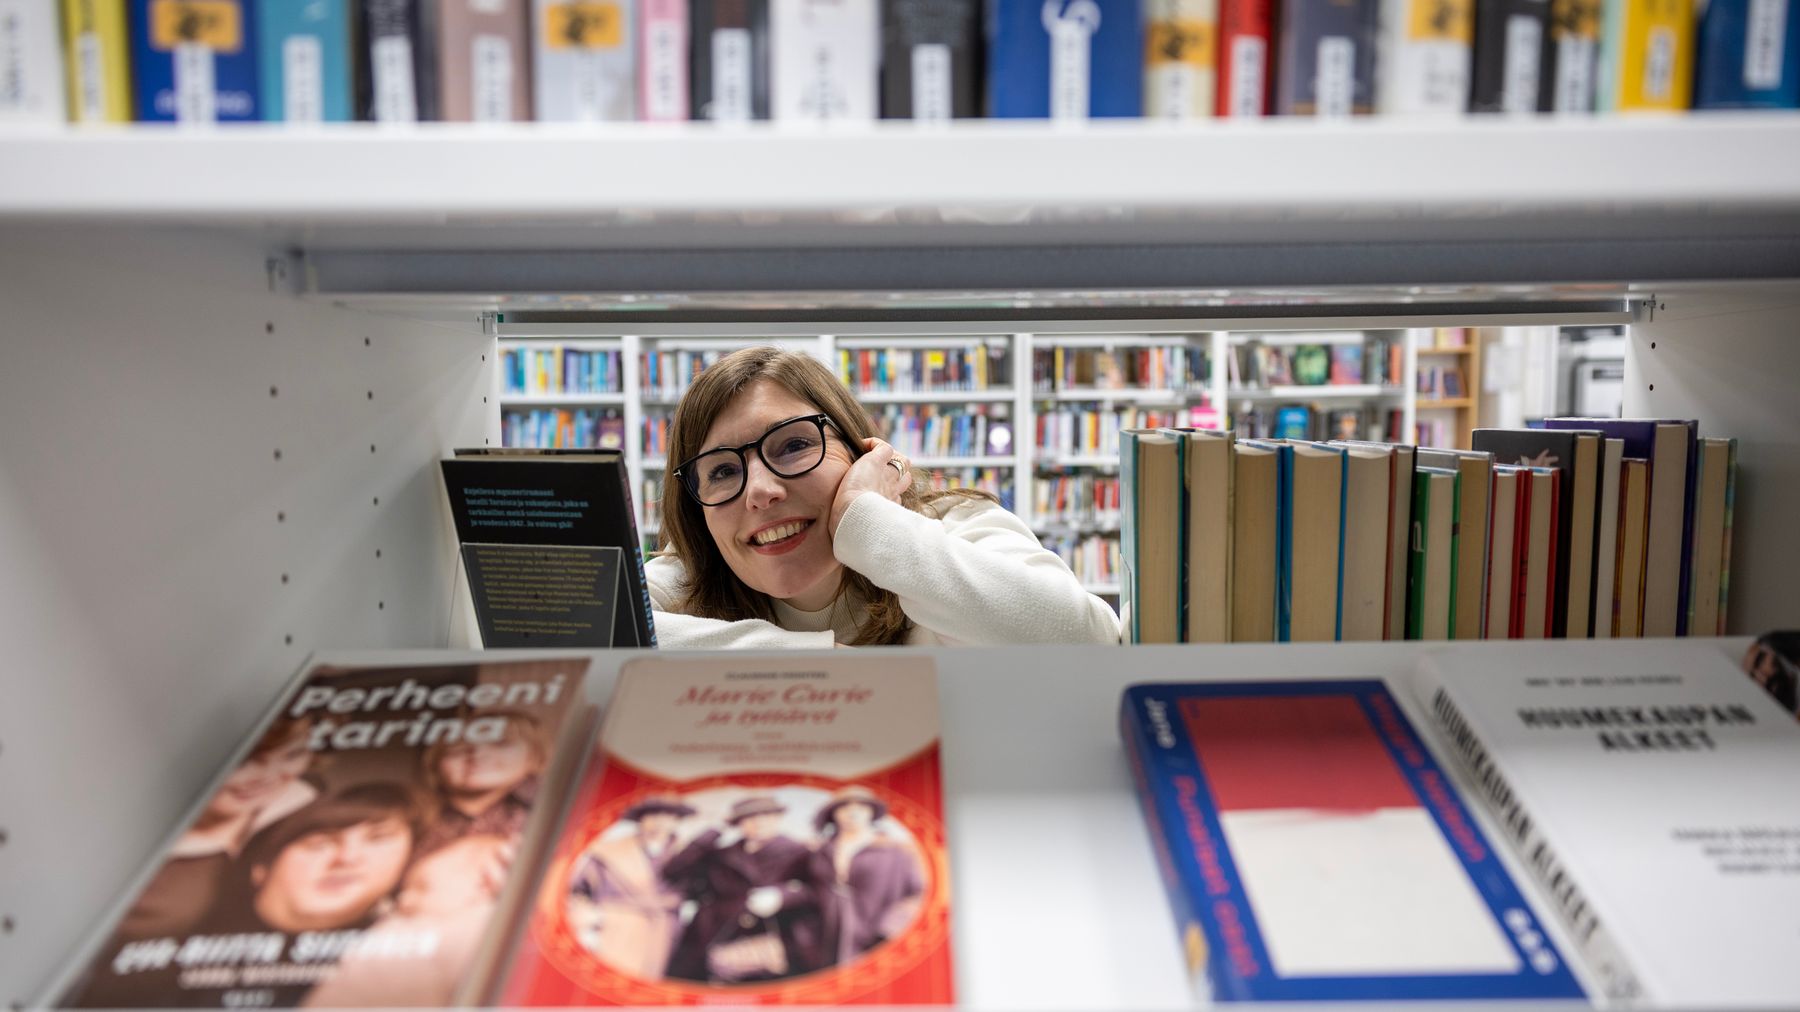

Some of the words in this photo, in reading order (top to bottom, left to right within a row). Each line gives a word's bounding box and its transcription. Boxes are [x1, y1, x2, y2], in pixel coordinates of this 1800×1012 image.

[674, 684, 776, 707] Marie
[781, 682, 874, 706] Curie
[1516, 704, 1756, 729] HUUMEKAUPAN
[307, 710, 508, 750] tarina
[1598, 728, 1717, 751] ALKEET
